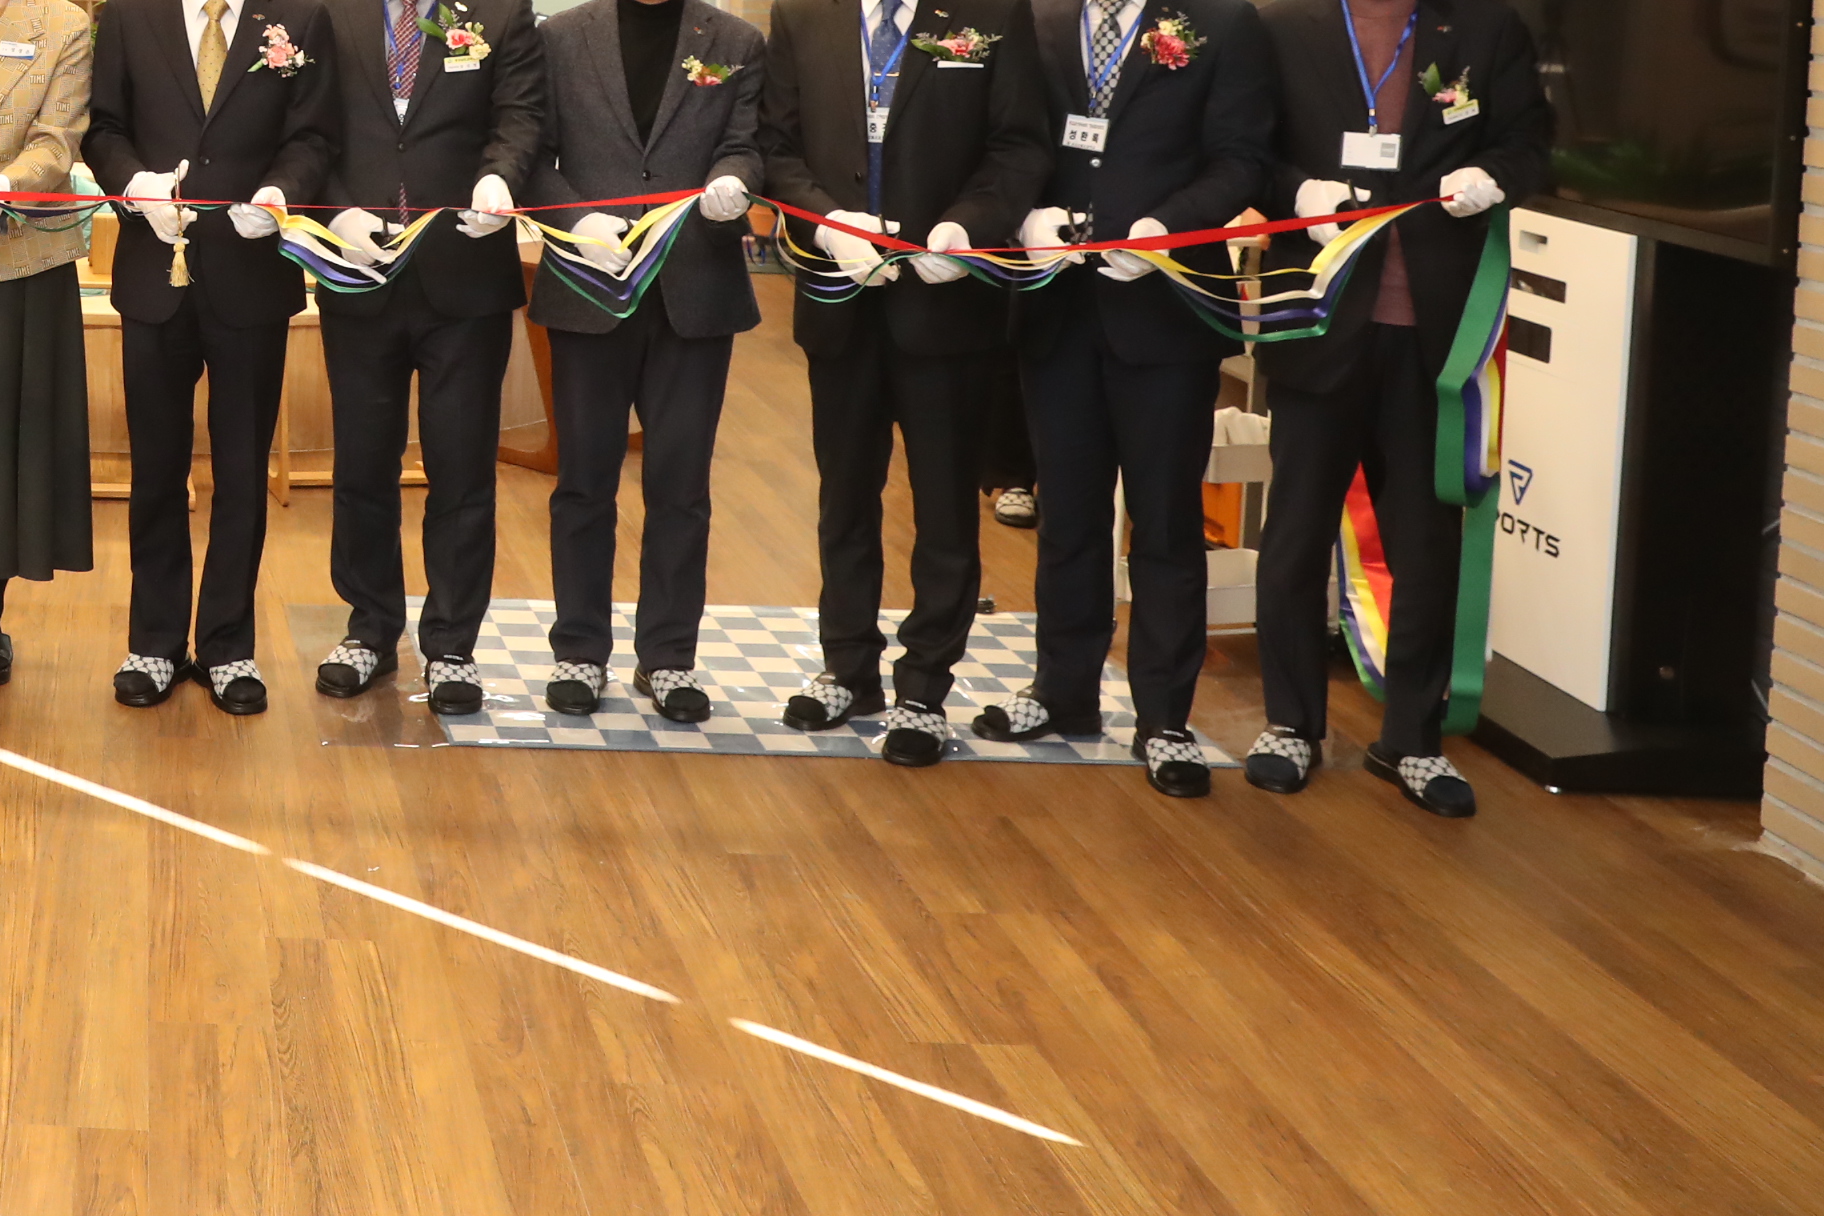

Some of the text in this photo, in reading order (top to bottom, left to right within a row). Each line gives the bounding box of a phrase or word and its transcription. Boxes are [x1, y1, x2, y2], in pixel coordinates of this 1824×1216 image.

[30, 75, 45, 83] TIME
[57, 102, 70, 112] TIME
[0, 115, 13, 124] TIME
[31, 162, 44, 176] TIME
[67, 248, 80, 259] TIME
[42, 257, 54, 267] TIME
[16, 265, 30, 275] TIME
[1498, 511, 1561, 559] ORTS
